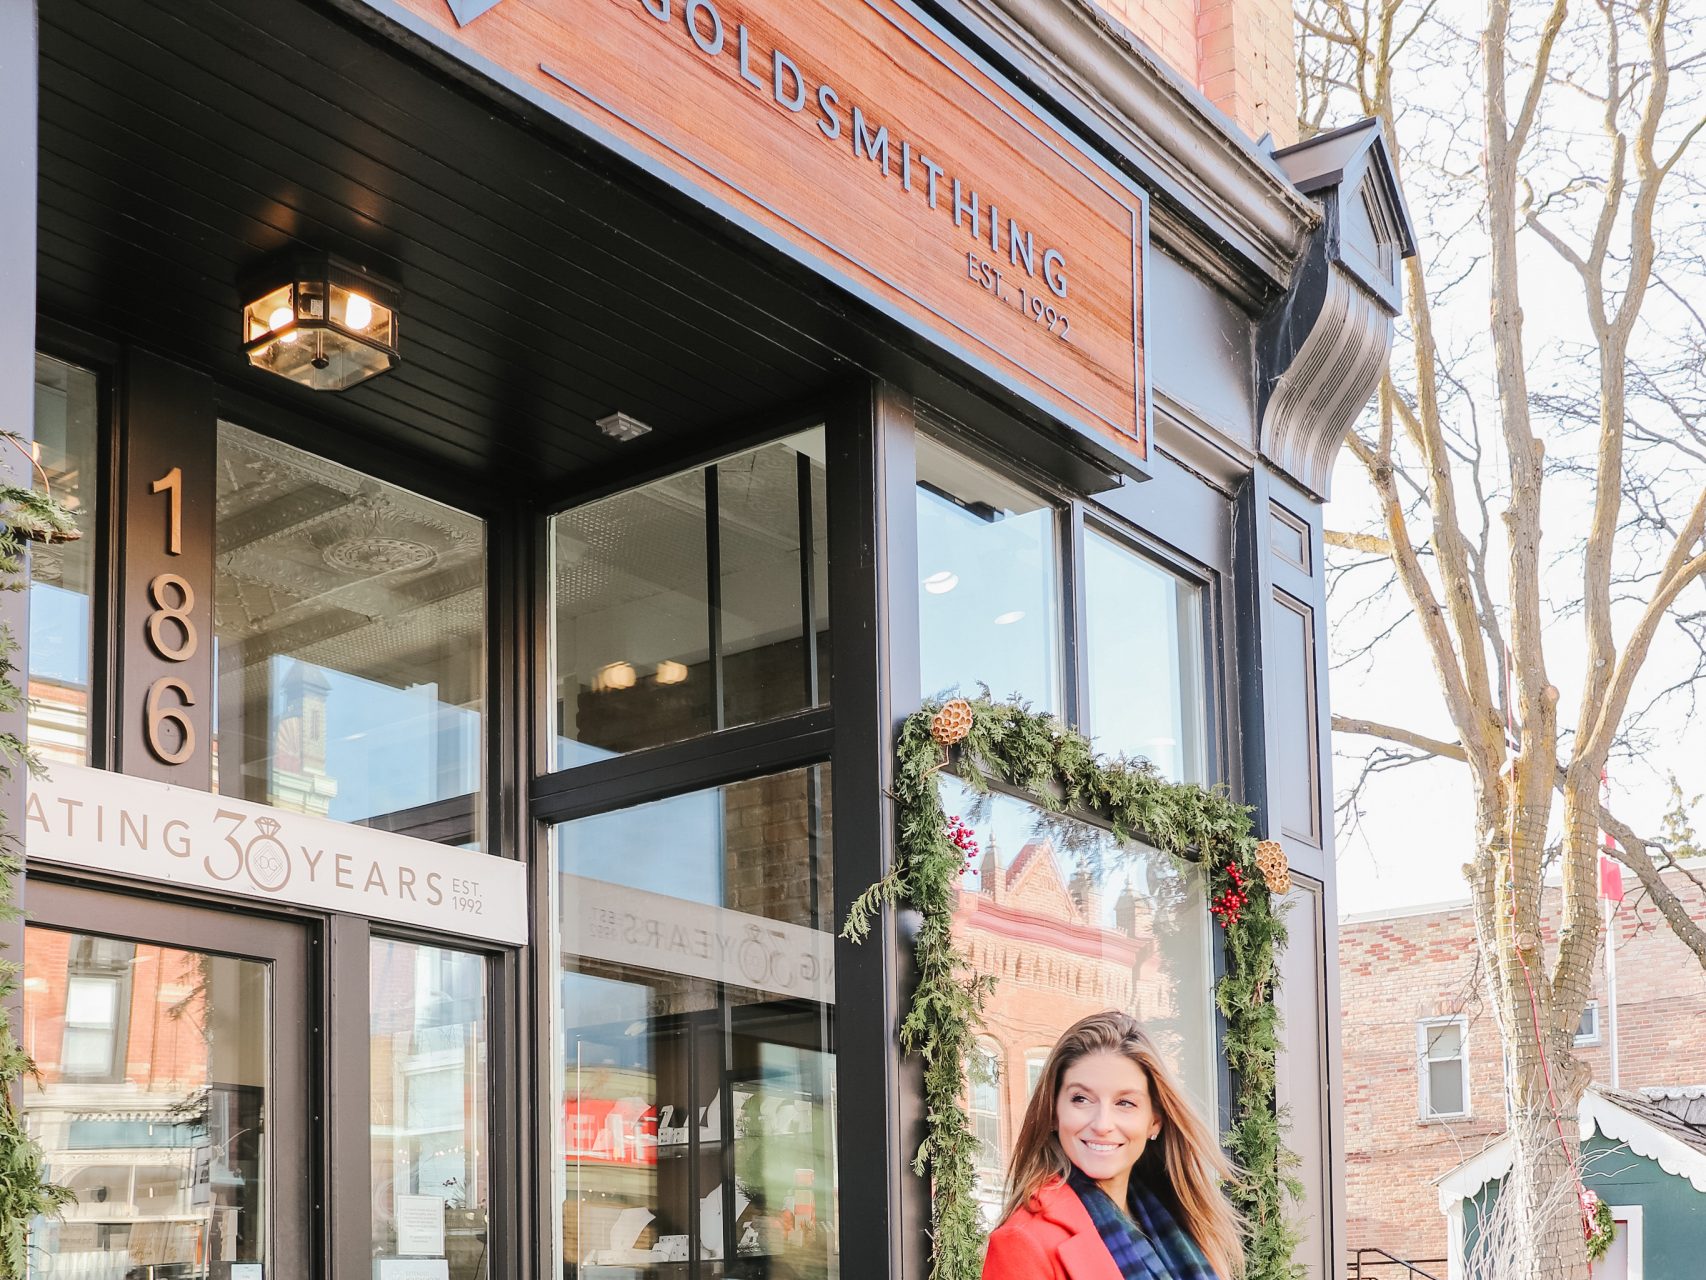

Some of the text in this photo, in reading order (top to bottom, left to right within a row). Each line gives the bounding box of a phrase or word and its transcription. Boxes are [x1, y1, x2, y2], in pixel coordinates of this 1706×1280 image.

[968, 251, 1070, 340] EST. 1992
[147, 466, 197, 764] 186
[300, 846, 443, 906] YEARS
[452, 877, 483, 898] EST.
[452, 895, 483, 915] 1992
